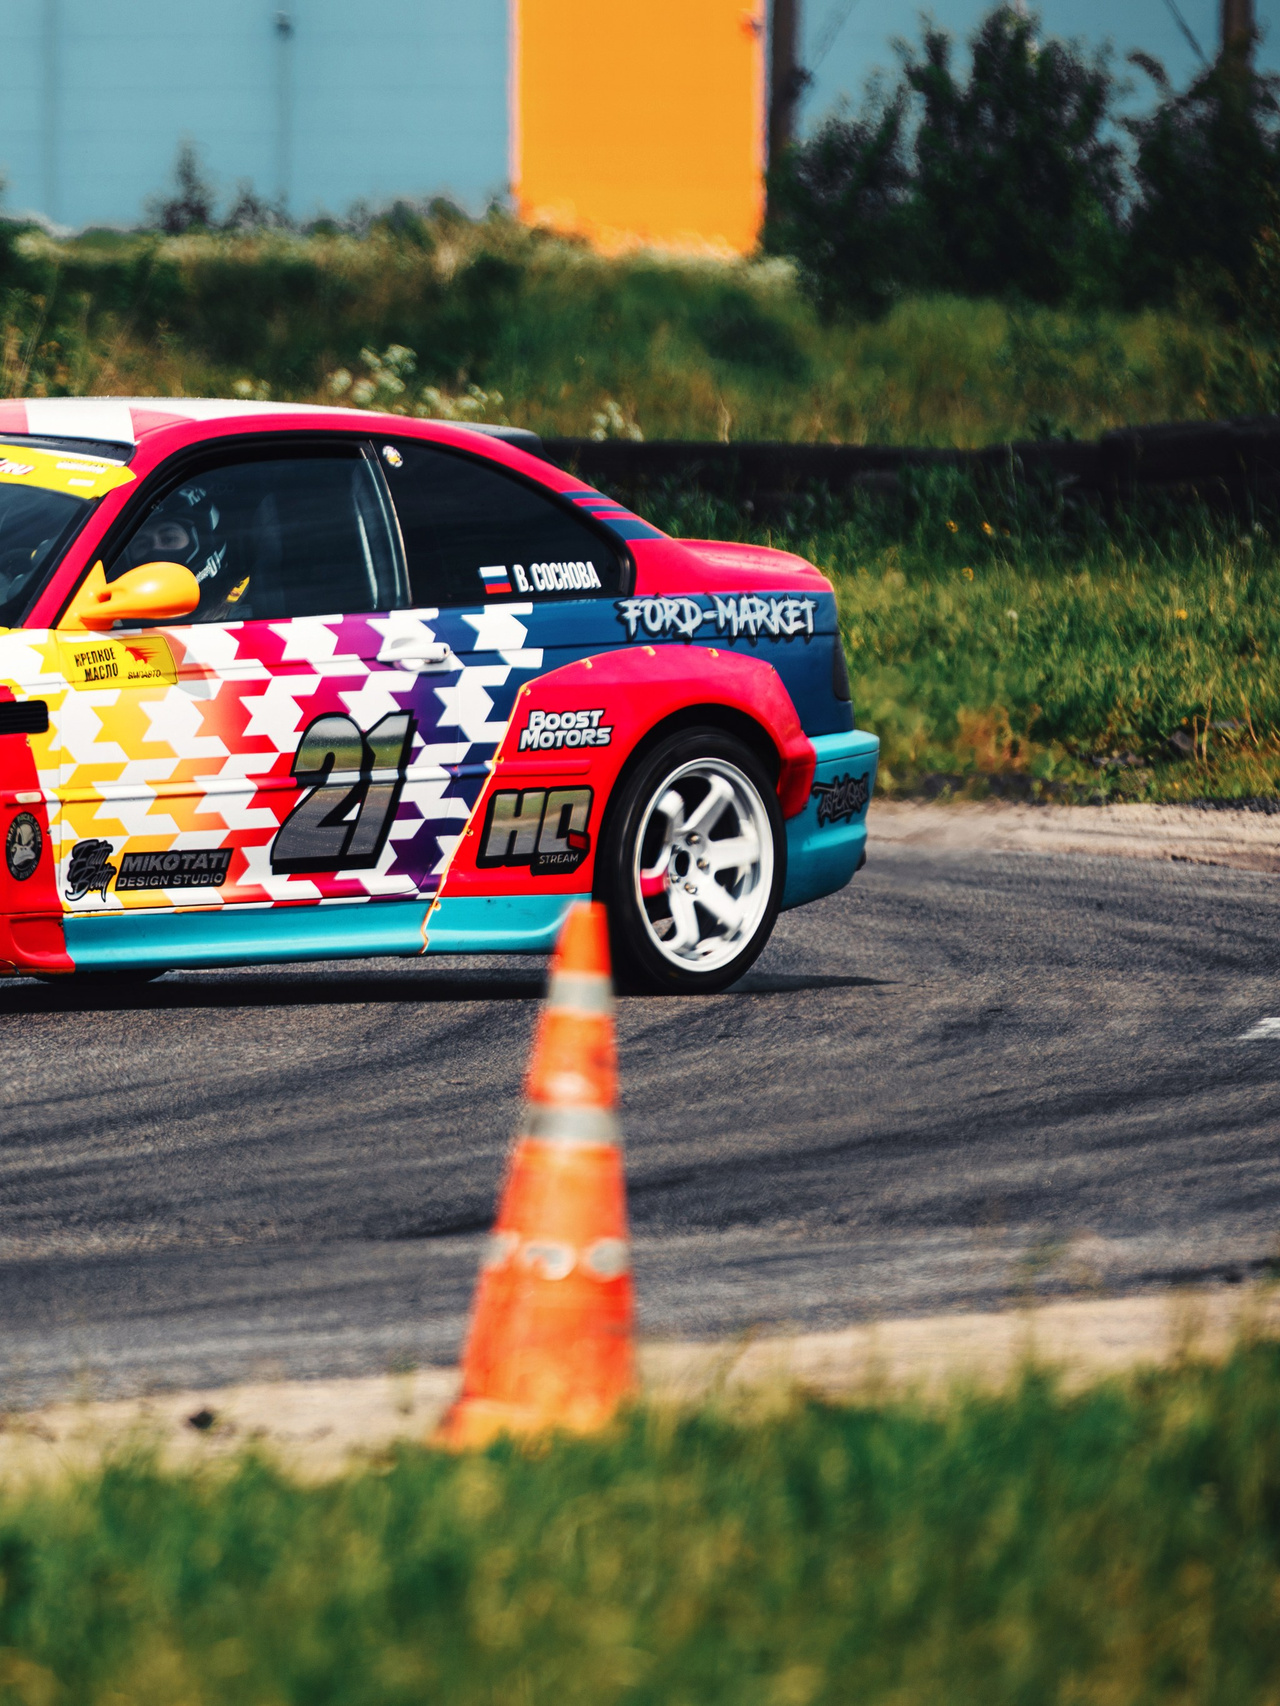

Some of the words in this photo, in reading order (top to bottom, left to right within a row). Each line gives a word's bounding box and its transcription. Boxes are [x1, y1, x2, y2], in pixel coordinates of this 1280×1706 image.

[616, 593, 818, 640] FORD-MARKET
[74, 647, 116, 667] КРЕПКОЕ
[84, 662, 119, 682] МАСЛО
[529, 710, 605, 731] BOOST
[519, 727, 612, 750] MOTORS
[271, 711, 417, 872] 21
[481, 787, 593, 862] HQ
[122, 851, 232, 873] MIKOTATI
[538, 853, 579, 865] STREAM
[117, 874, 170, 888] DESIGN
[173, 872, 224, 885] STUDIO
